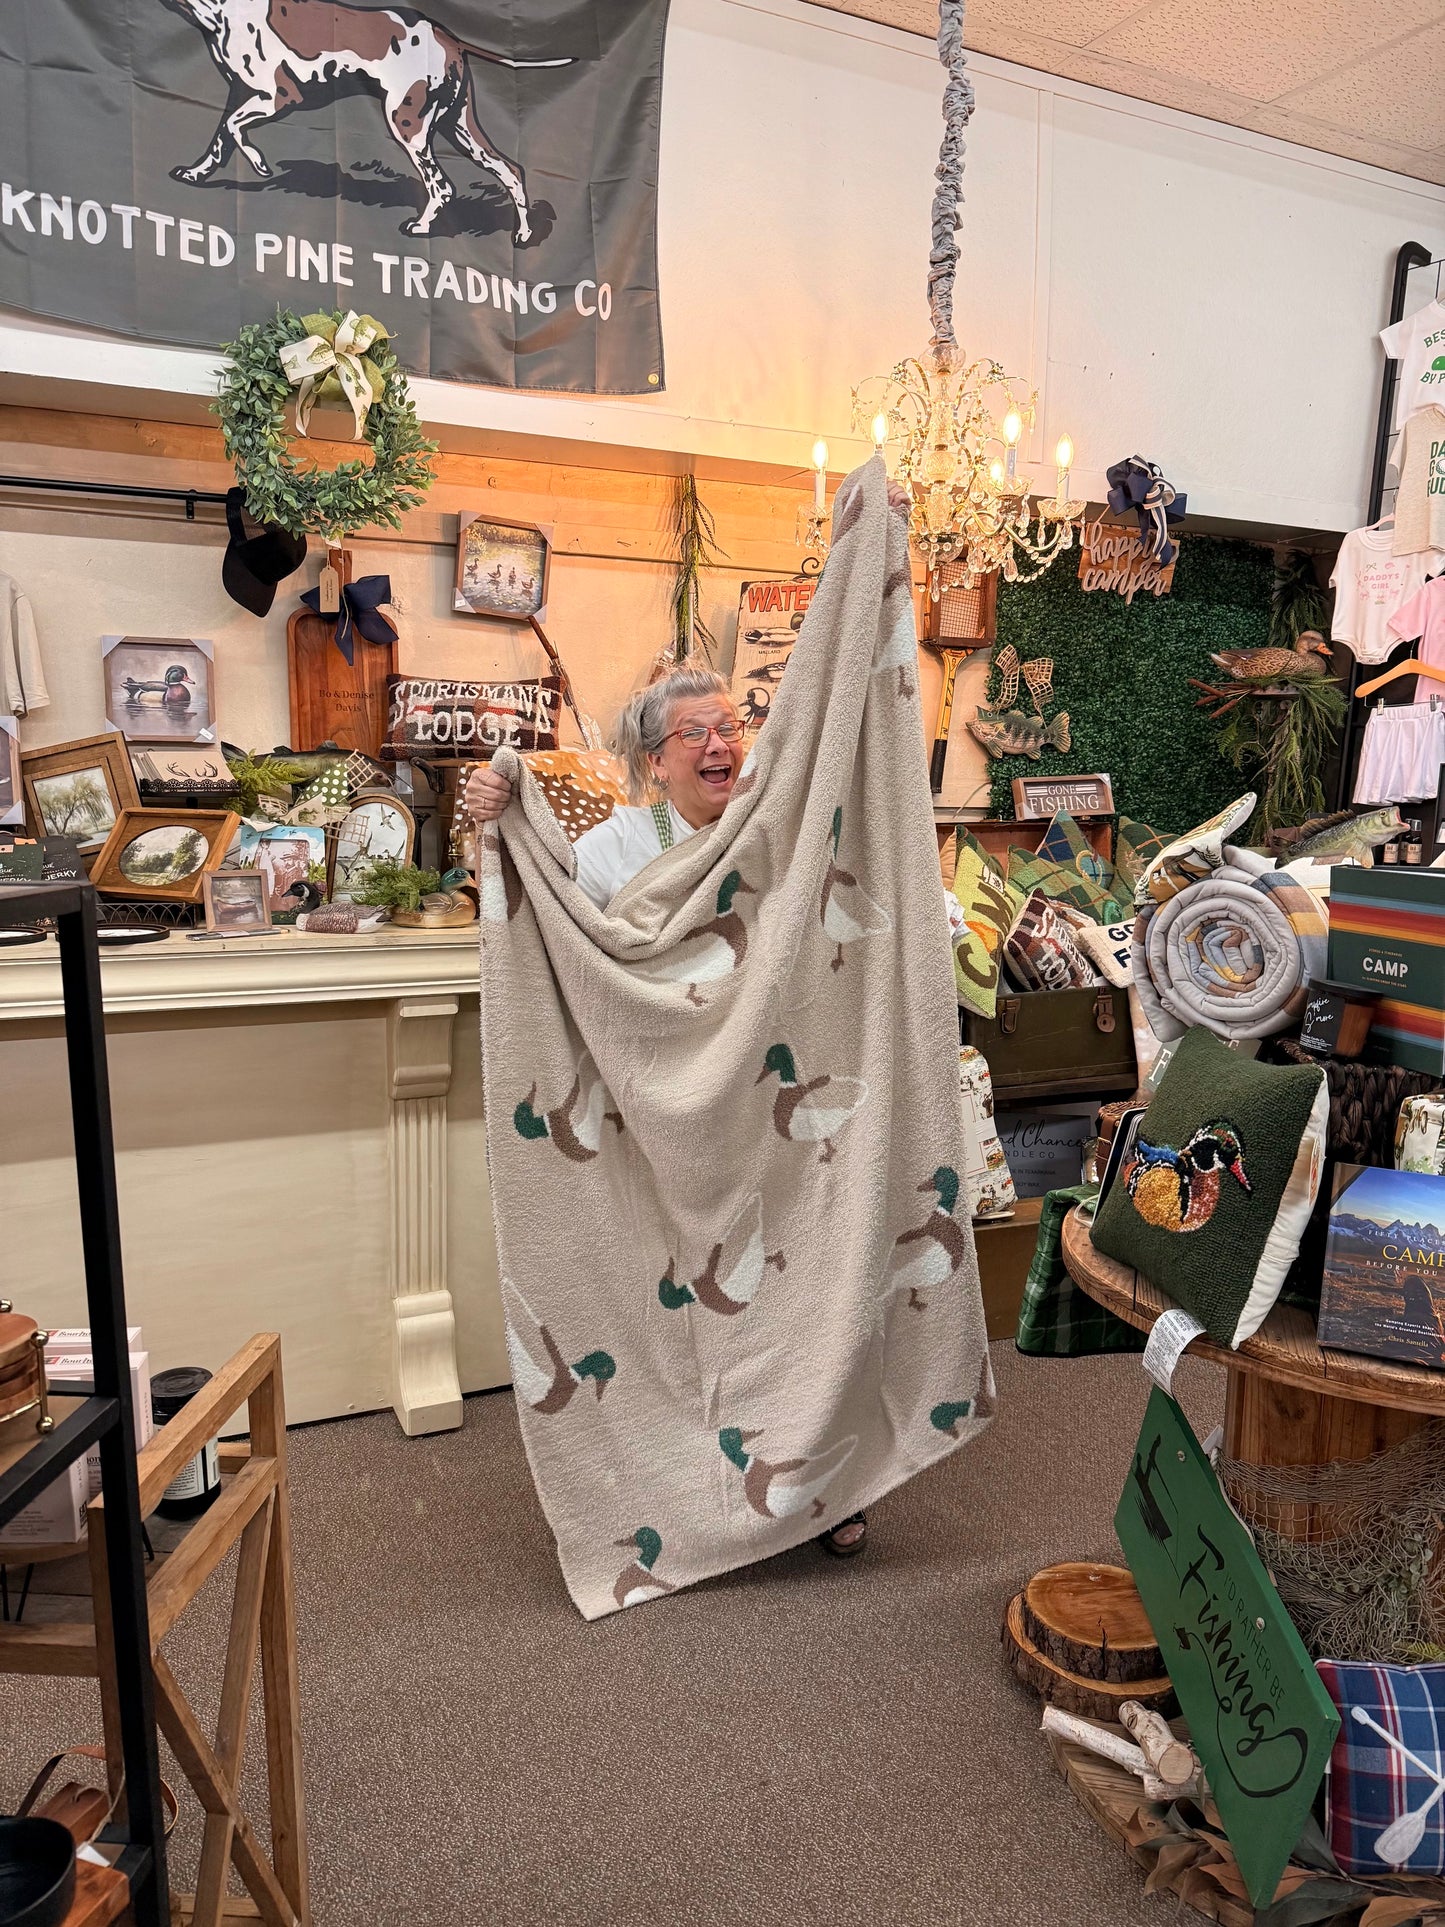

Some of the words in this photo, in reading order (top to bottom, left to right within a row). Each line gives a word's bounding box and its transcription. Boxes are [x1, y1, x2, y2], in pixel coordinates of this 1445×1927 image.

[2, 182, 235, 268] KNOTTED
[256, 232, 354, 287] PINE
[373, 252, 557, 316] TRADING
[574, 279, 612, 321] CO
[1363, 573, 1400, 582] DADDY'S
[1082, 567, 1167, 605] camper
[319, 689, 332, 699] Bo
[333, 690, 341, 699] &
[342, 690, 375, 699] Denise
[335, 703, 362, 712] Davis
[405, 711, 523, 746] LODGE
[1048, 785, 1076, 796] GONE
[1028, 794, 1100, 813] FISHING
[44, 870, 77, 881] JERKY
[1363, 957, 1409, 978] CAMP
[1368, 1230, 1399, 1239] FIFTY
[1366, 1260, 1408, 1272] BEFORE
[1416, 1268, 1438, 1277] YOU
[1398, 1326, 1417, 1334] Greatest
[1235, 1598, 1272, 1680] RATHER
[1269, 1675, 1286, 1711] BE
